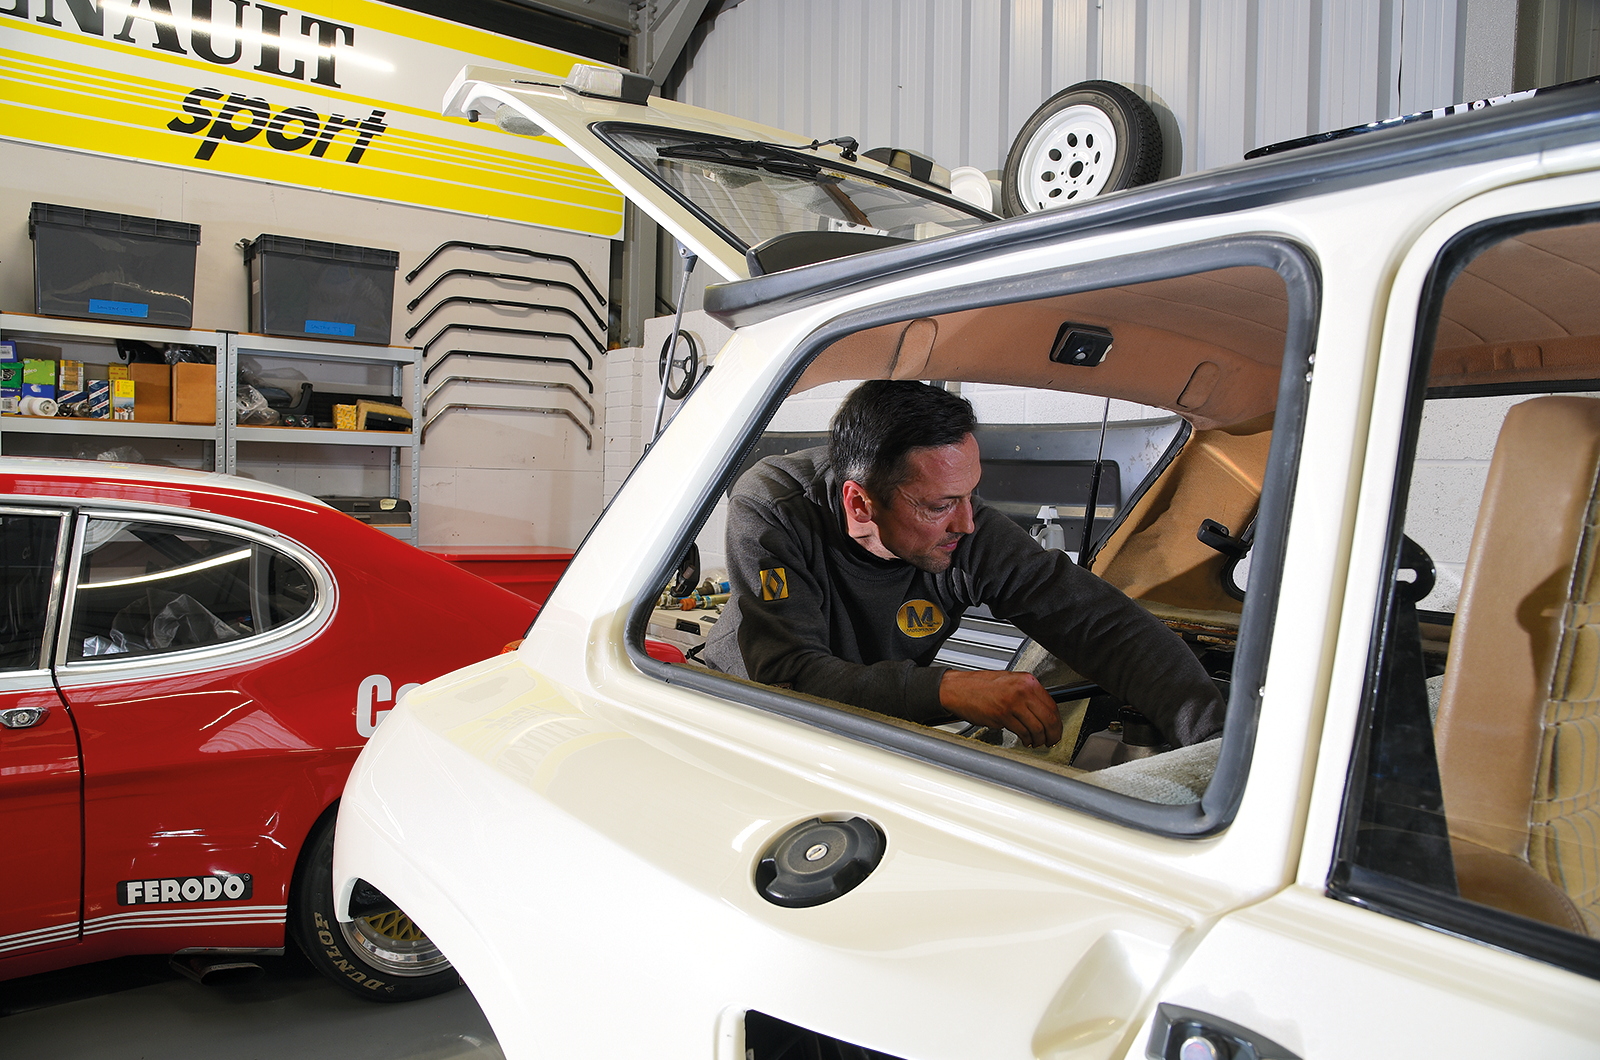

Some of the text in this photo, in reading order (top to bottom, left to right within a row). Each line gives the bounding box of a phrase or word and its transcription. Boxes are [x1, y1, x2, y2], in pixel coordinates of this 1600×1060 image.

[0, 0, 354, 89] NAULT
[166, 86, 389, 164] sport
[356, 674, 422, 738] C
[127, 875, 245, 905] FERODO
[313, 911, 386, 991] DUNLOP
